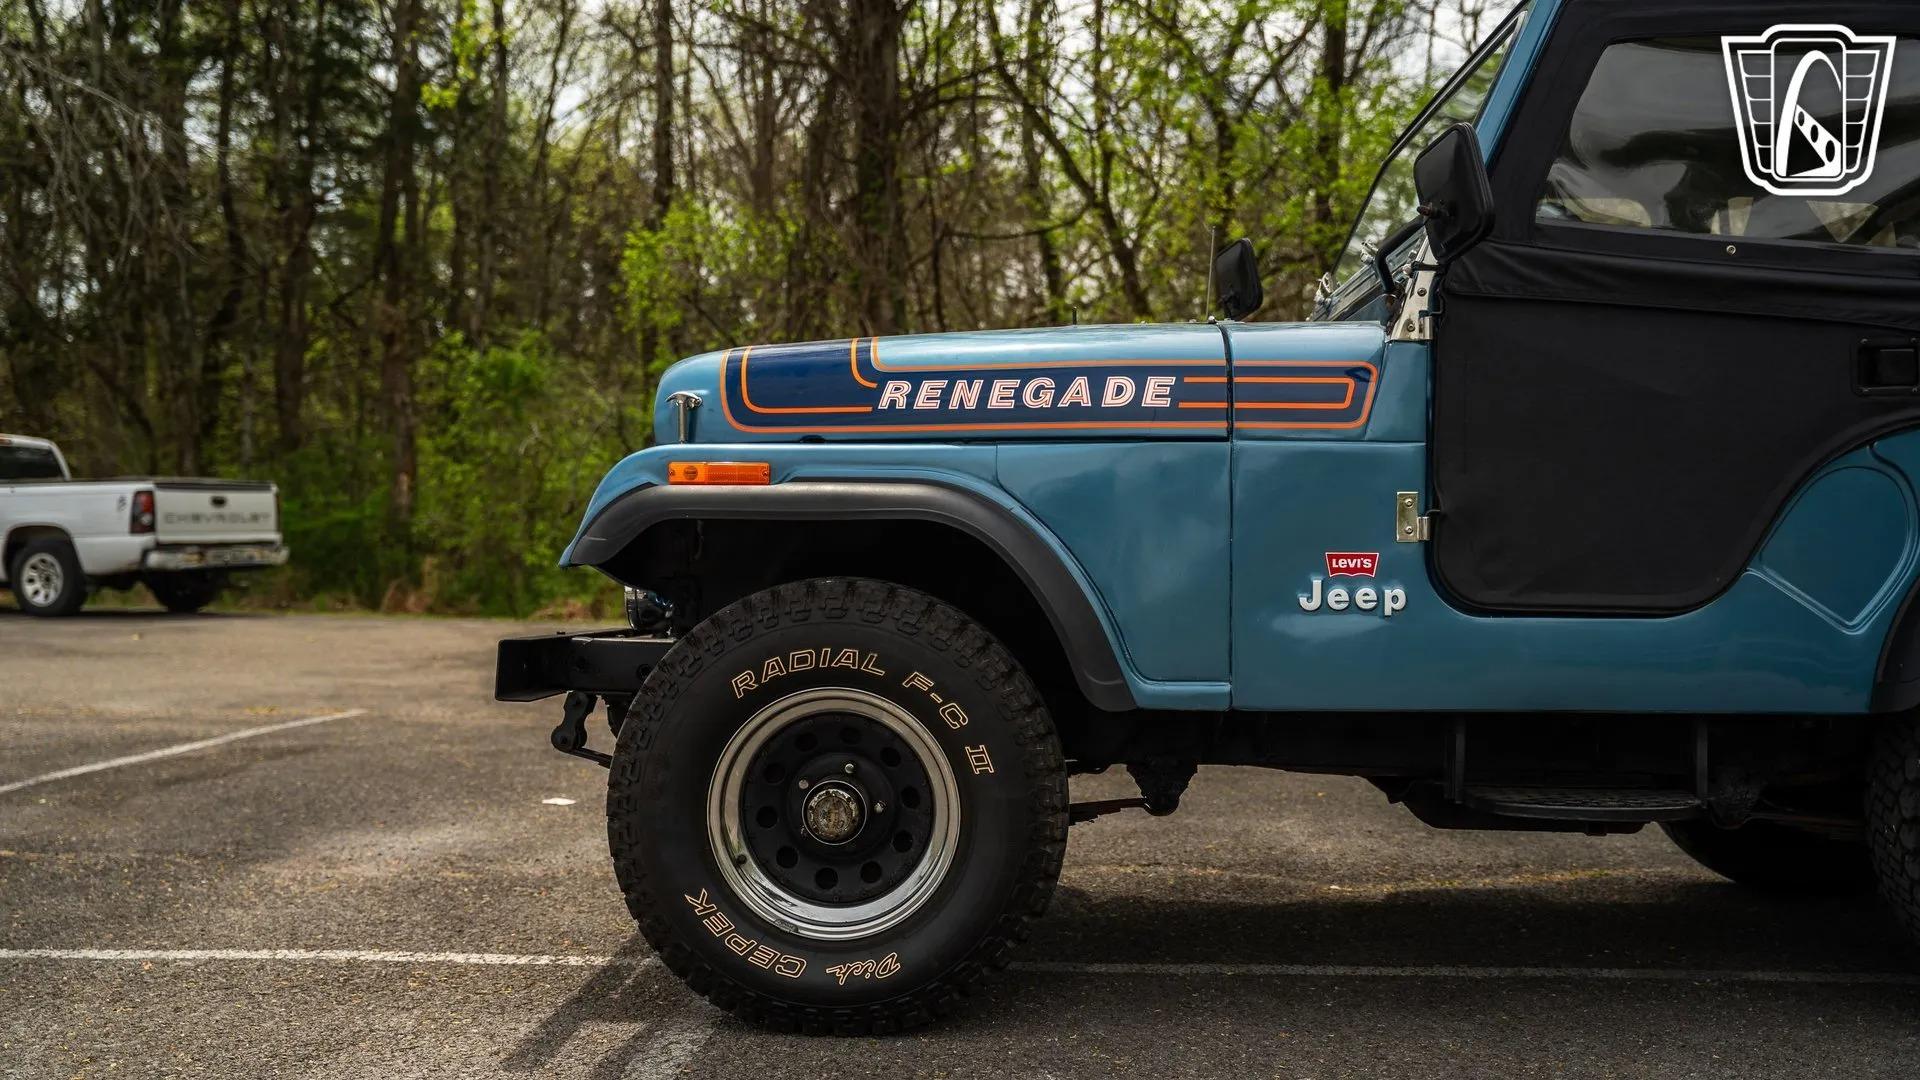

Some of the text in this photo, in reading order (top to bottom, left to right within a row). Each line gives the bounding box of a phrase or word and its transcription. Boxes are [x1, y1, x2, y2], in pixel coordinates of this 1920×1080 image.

[877, 376, 1176, 410] RENEGADE
[163, 512, 271, 524] CHEVROLET
[1299, 579, 1407, 616] Jeep
[731, 648, 886, 699] RADIAL
[902, 671, 969, 729] F-C
[684, 888, 901, 986] Dick CEPEK
